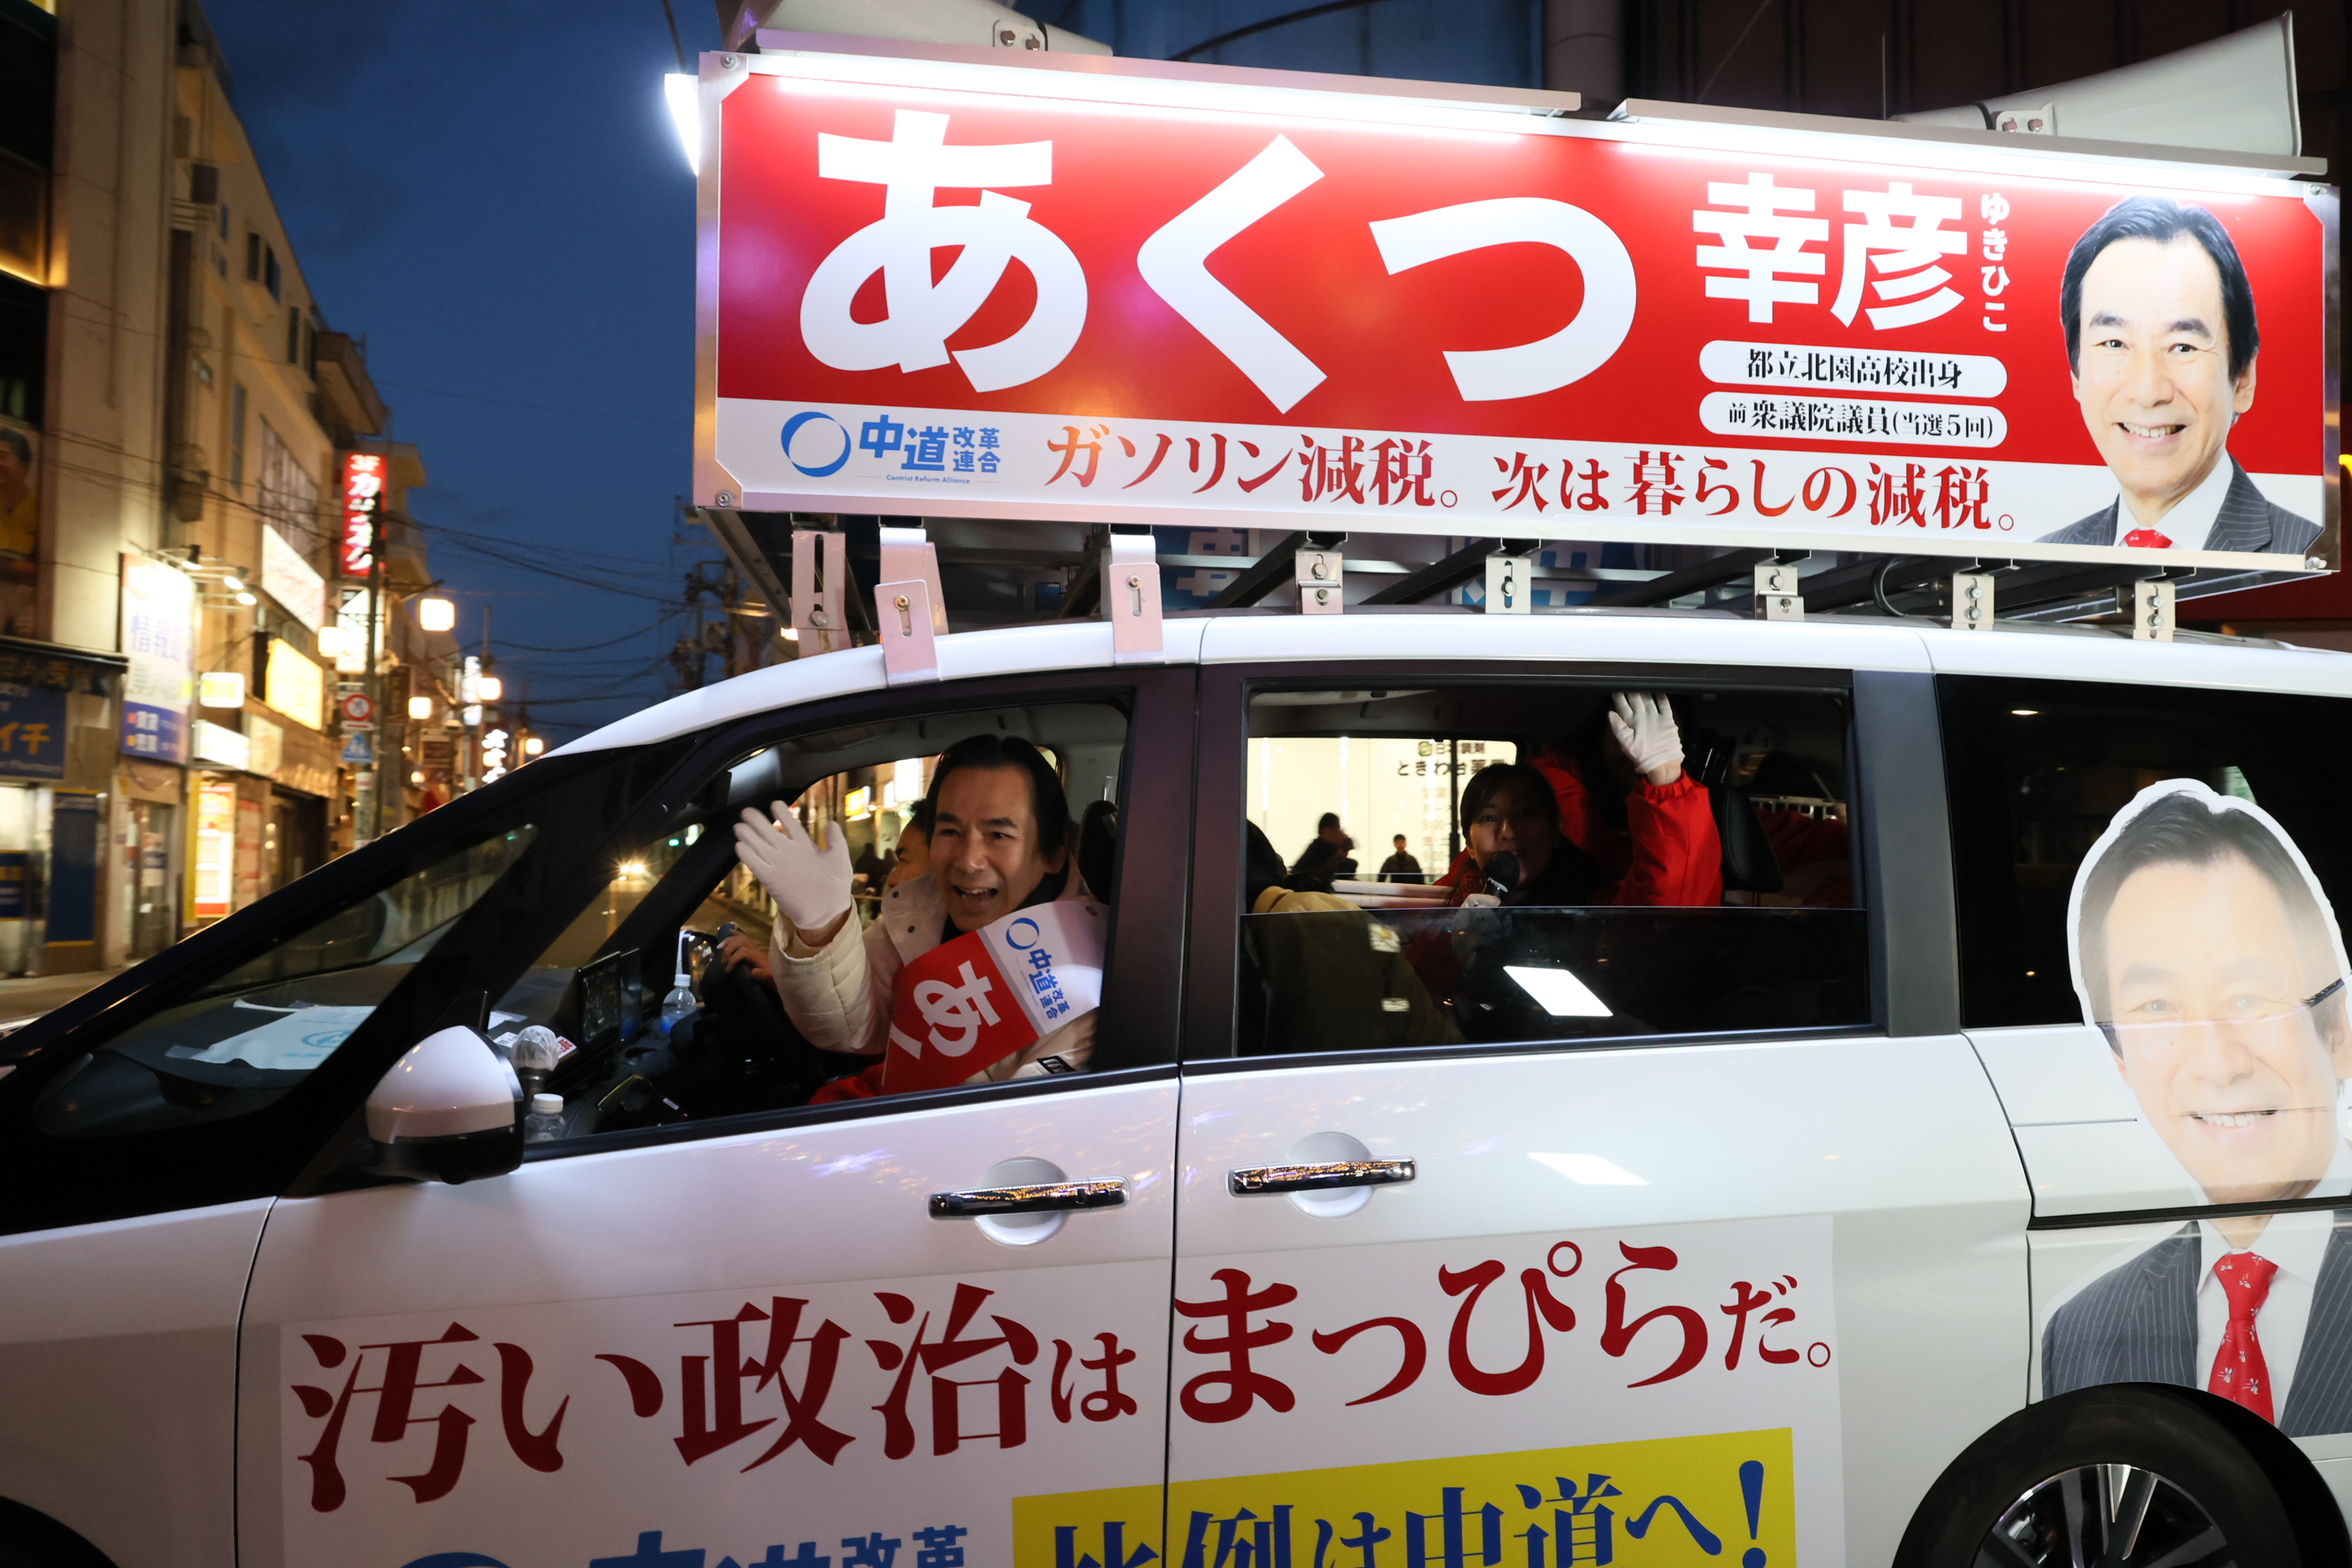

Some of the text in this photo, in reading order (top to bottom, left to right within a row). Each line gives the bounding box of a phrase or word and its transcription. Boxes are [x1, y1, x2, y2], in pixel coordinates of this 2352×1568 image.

[800, 108, 1638, 415] あくつ
[1692, 172, 1968, 331] 幸彦
[1981, 192, 2011, 333] ゆきひこ
[1745, 348, 1963, 390] 都立北園高校出身
[859, 414, 949, 471] 中道
[952, 426, 1001, 450] 改革
[1728, 399, 1993, 440] 前衆議院議員(当選5回)
[952, 450, 1001, 473] 連合
[290, 1240, 1830, 1513] 汚い政治はまっぴらだ。
